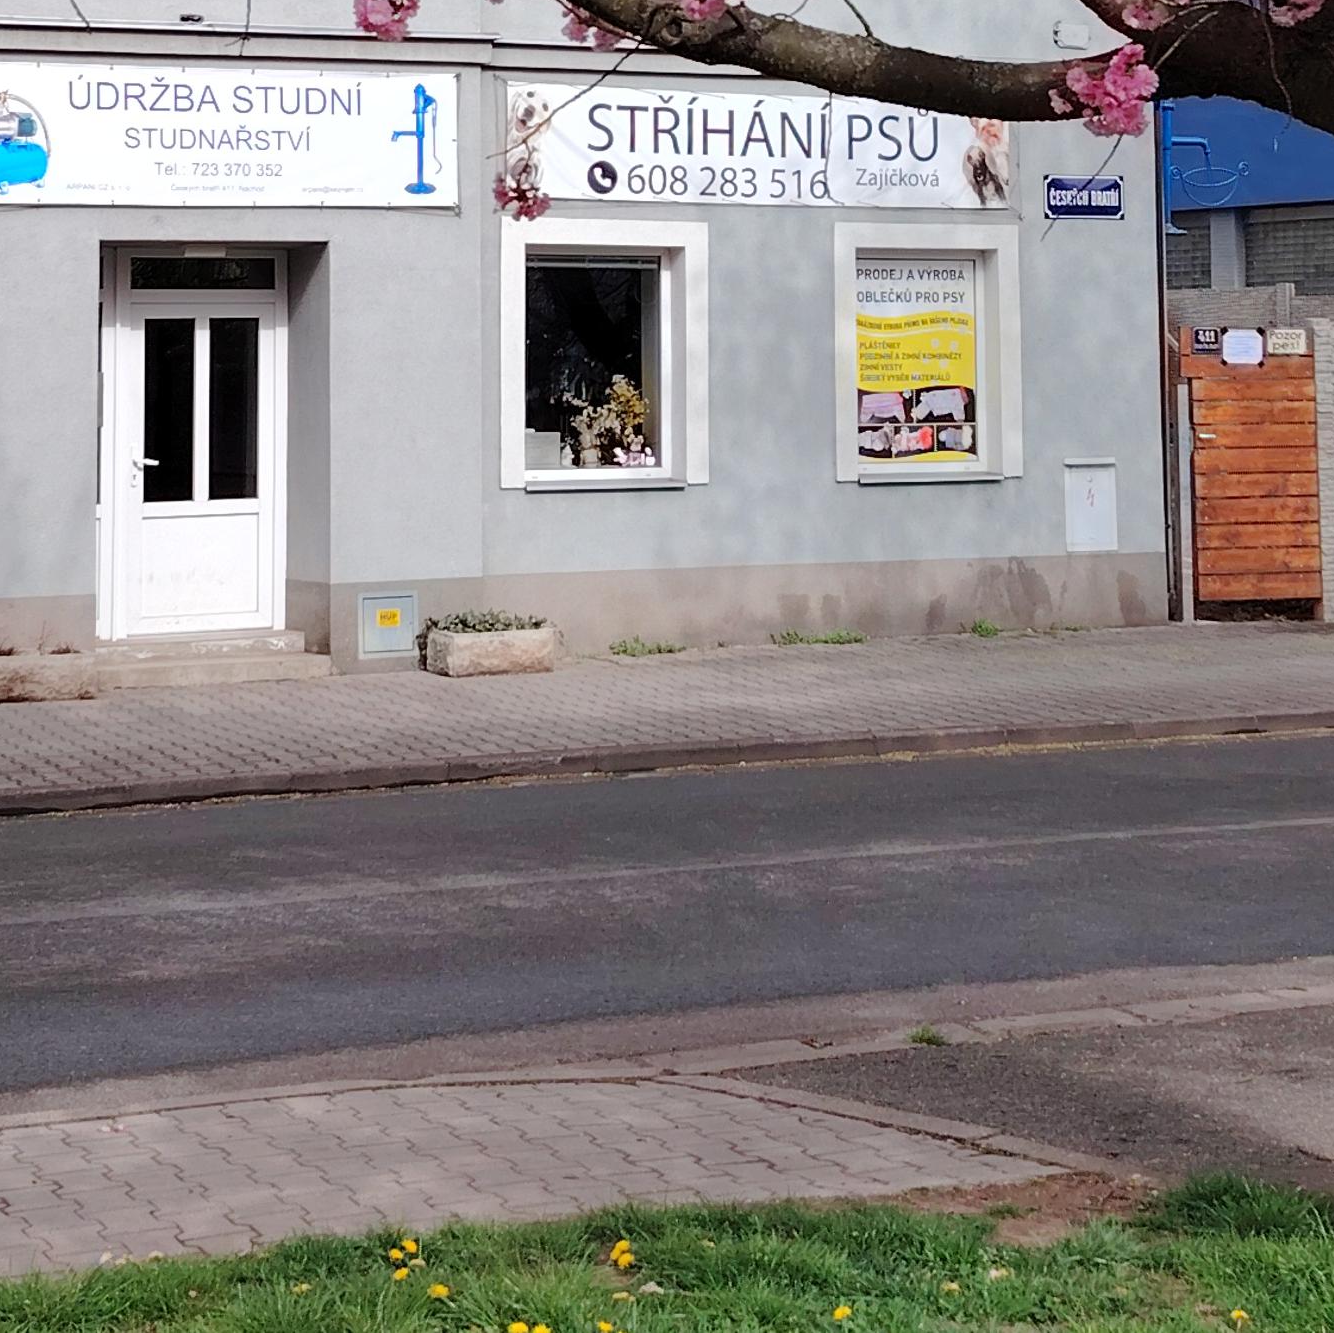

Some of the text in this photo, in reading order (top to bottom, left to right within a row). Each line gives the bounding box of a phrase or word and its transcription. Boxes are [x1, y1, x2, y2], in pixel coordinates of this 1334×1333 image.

[69, 74, 362, 116] ÚDRŽBA STUDNÍ
[124, 125, 310, 151] STUDNAŘSTVÍ
[587, 95, 938, 162] STŘÍHÁNÍ PSŮ
[192, 163, 219, 177] 723
[224, 163, 251, 177] 370
[256, 163, 283, 177] 352
[855, 168, 939, 191] Zajíčková
[627, 164, 828, 199] 608 283 516
[1049, 187, 1089, 206] ČESKÝCH
[856, 266, 965, 281] PRODEJ A VÝROBA
[856, 288, 965, 303] OBLEČKŮ PRO PSY
[1269, 330, 1302, 340] Pozor
